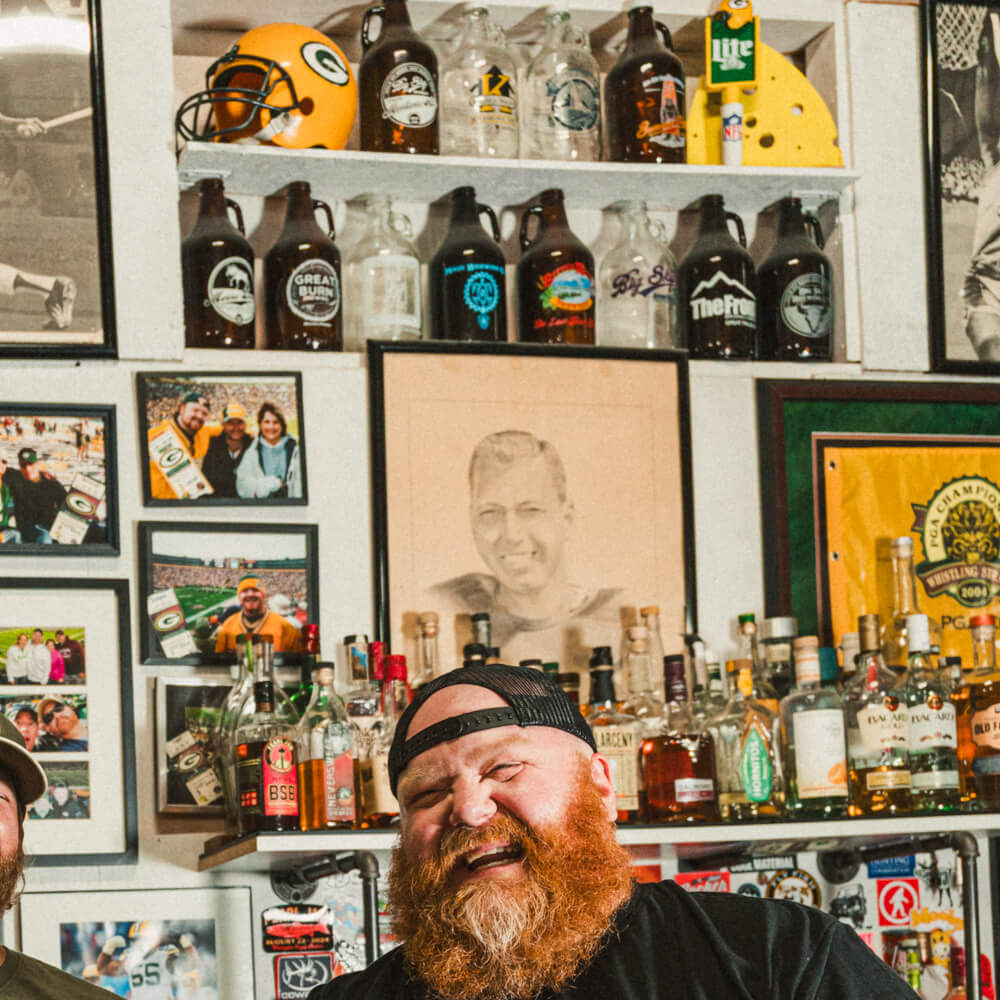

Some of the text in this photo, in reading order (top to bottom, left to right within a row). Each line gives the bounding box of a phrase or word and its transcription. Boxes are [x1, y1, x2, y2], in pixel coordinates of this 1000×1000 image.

[711, 38, 754, 63] Lite
[294, 273, 337, 286] GREAT
[299, 286, 334, 298] BURN
[929, 519, 940, 548] PGA
[925, 565, 979, 588] WHISTLING
[960, 586, 988, 599] 2004
[941, 615, 971, 630] PG
[268, 784, 296, 801] BSB
